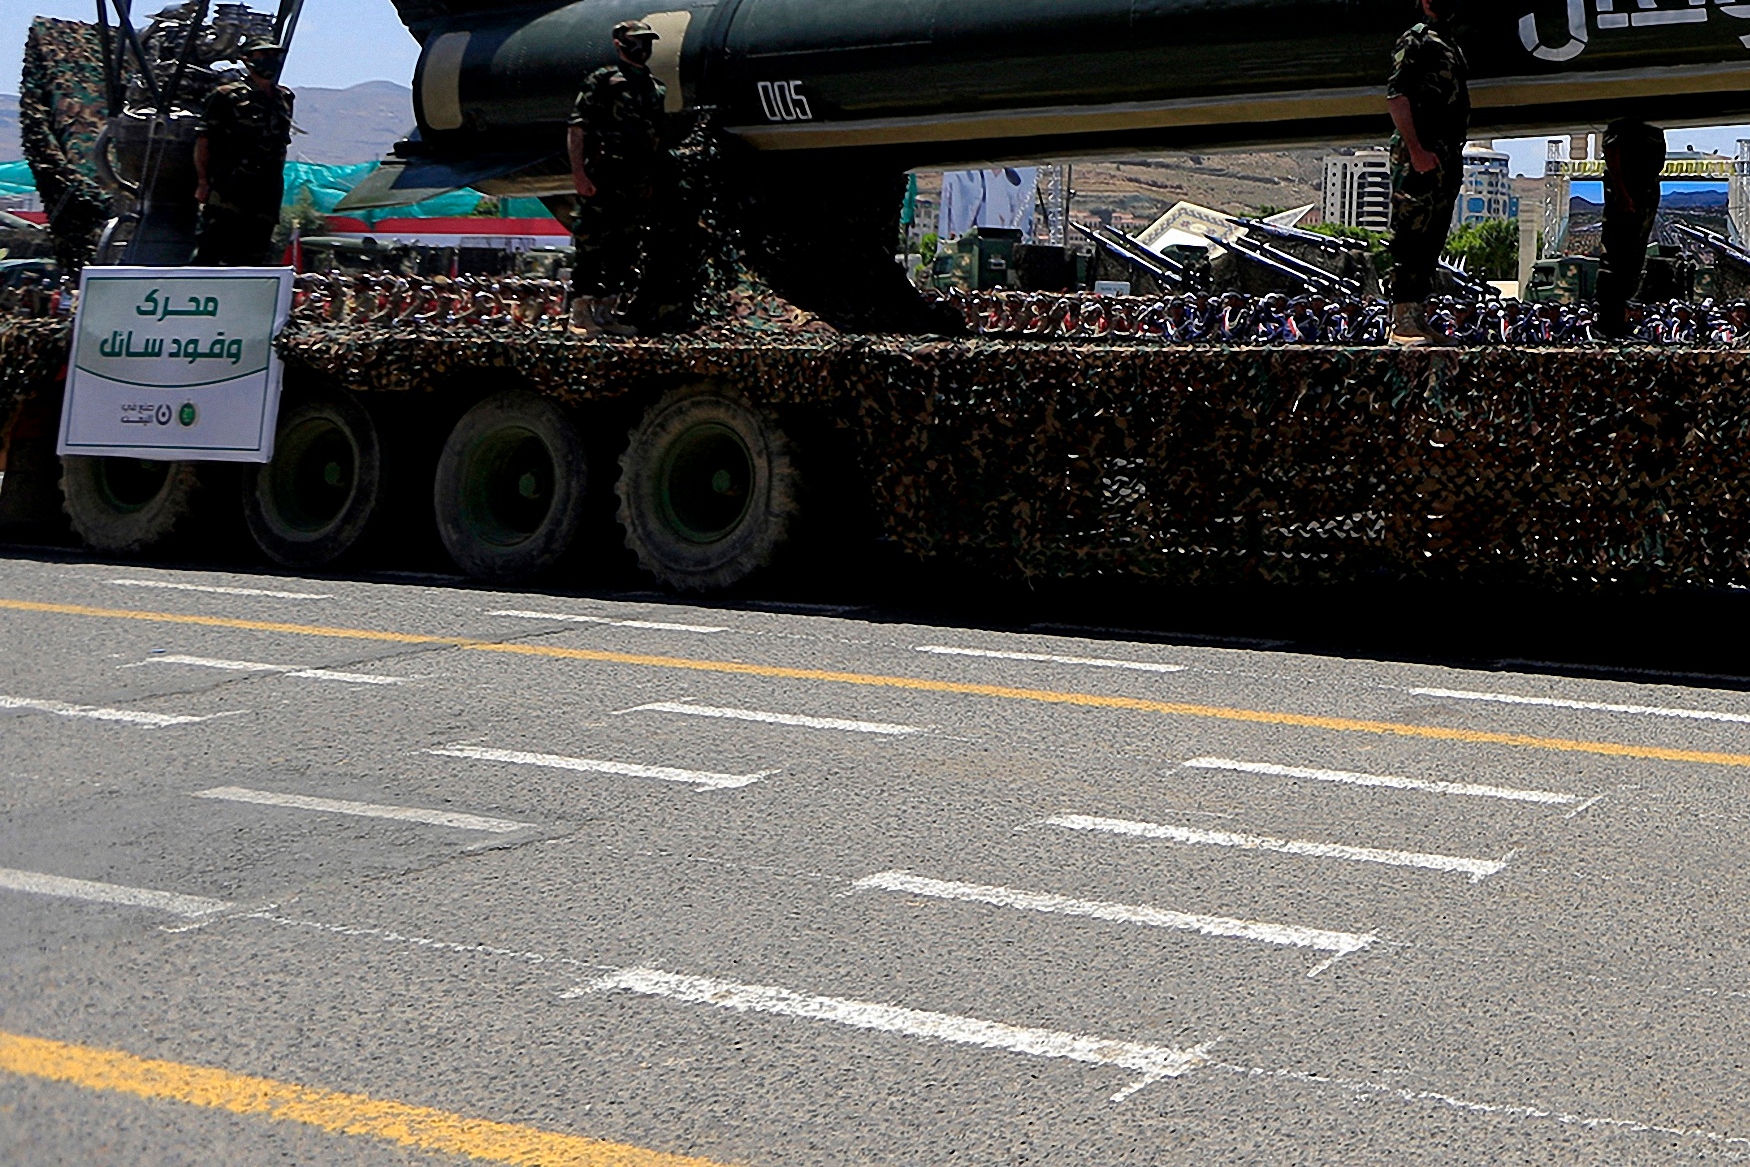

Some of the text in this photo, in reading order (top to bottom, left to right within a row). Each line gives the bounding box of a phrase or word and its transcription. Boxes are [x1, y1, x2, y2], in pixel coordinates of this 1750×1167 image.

[757, 79, 813, 121] 005
[136, 288, 218, 322] محرك
[99, 330, 243, 365] وقود سائل
